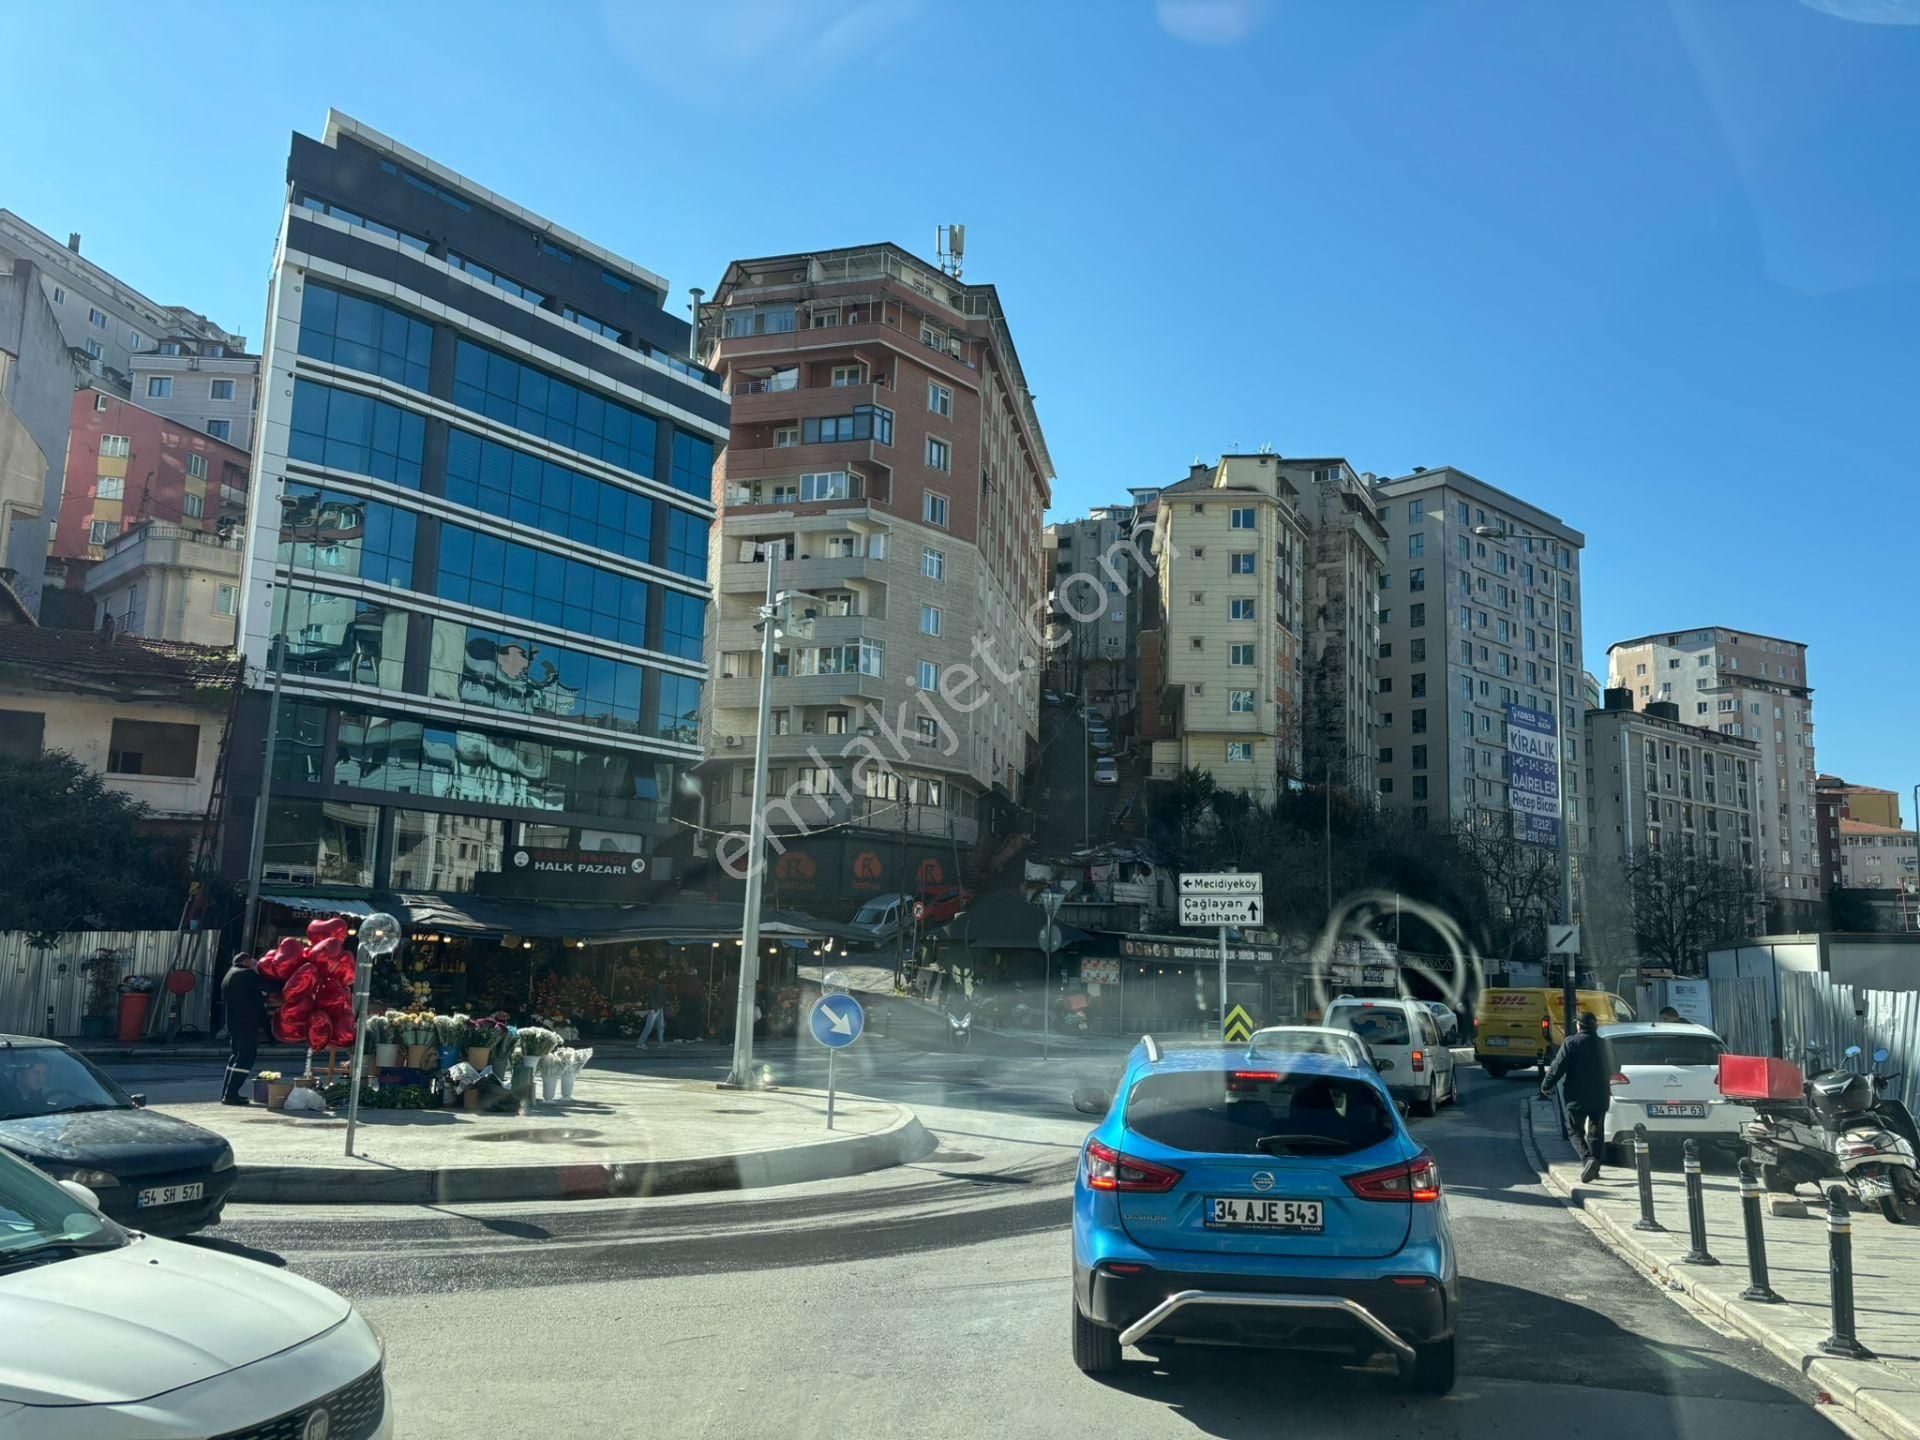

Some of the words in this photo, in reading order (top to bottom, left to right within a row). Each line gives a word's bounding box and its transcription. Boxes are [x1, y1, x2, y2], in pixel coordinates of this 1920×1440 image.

[1510, 729, 1555, 760] KİRALIK
[1512, 771, 1557, 798] DAİRELER
[1512, 790, 1536, 813] Recep
[534, 861, 574, 872] HALK
[577, 863, 627, 875] PAZARI
[1194, 878, 1257, 891] Mecidiyeköy
[1184, 898, 1243, 911] Çağlayan
[1184, 912, 1247, 924] Kağıthane
[1490, 996, 1528, 1005] DHL
[1690, 1106, 1703, 1115] 63
[143, 1190, 157, 1205] 54
[163, 1188, 176, 1202] SH
[182, 1184, 201, 1199] 571
[1215, 1200, 1238, 1221] 34
[1245, 1202, 1278, 1222] AJE
[1284, 1203, 1318, 1224] 543
